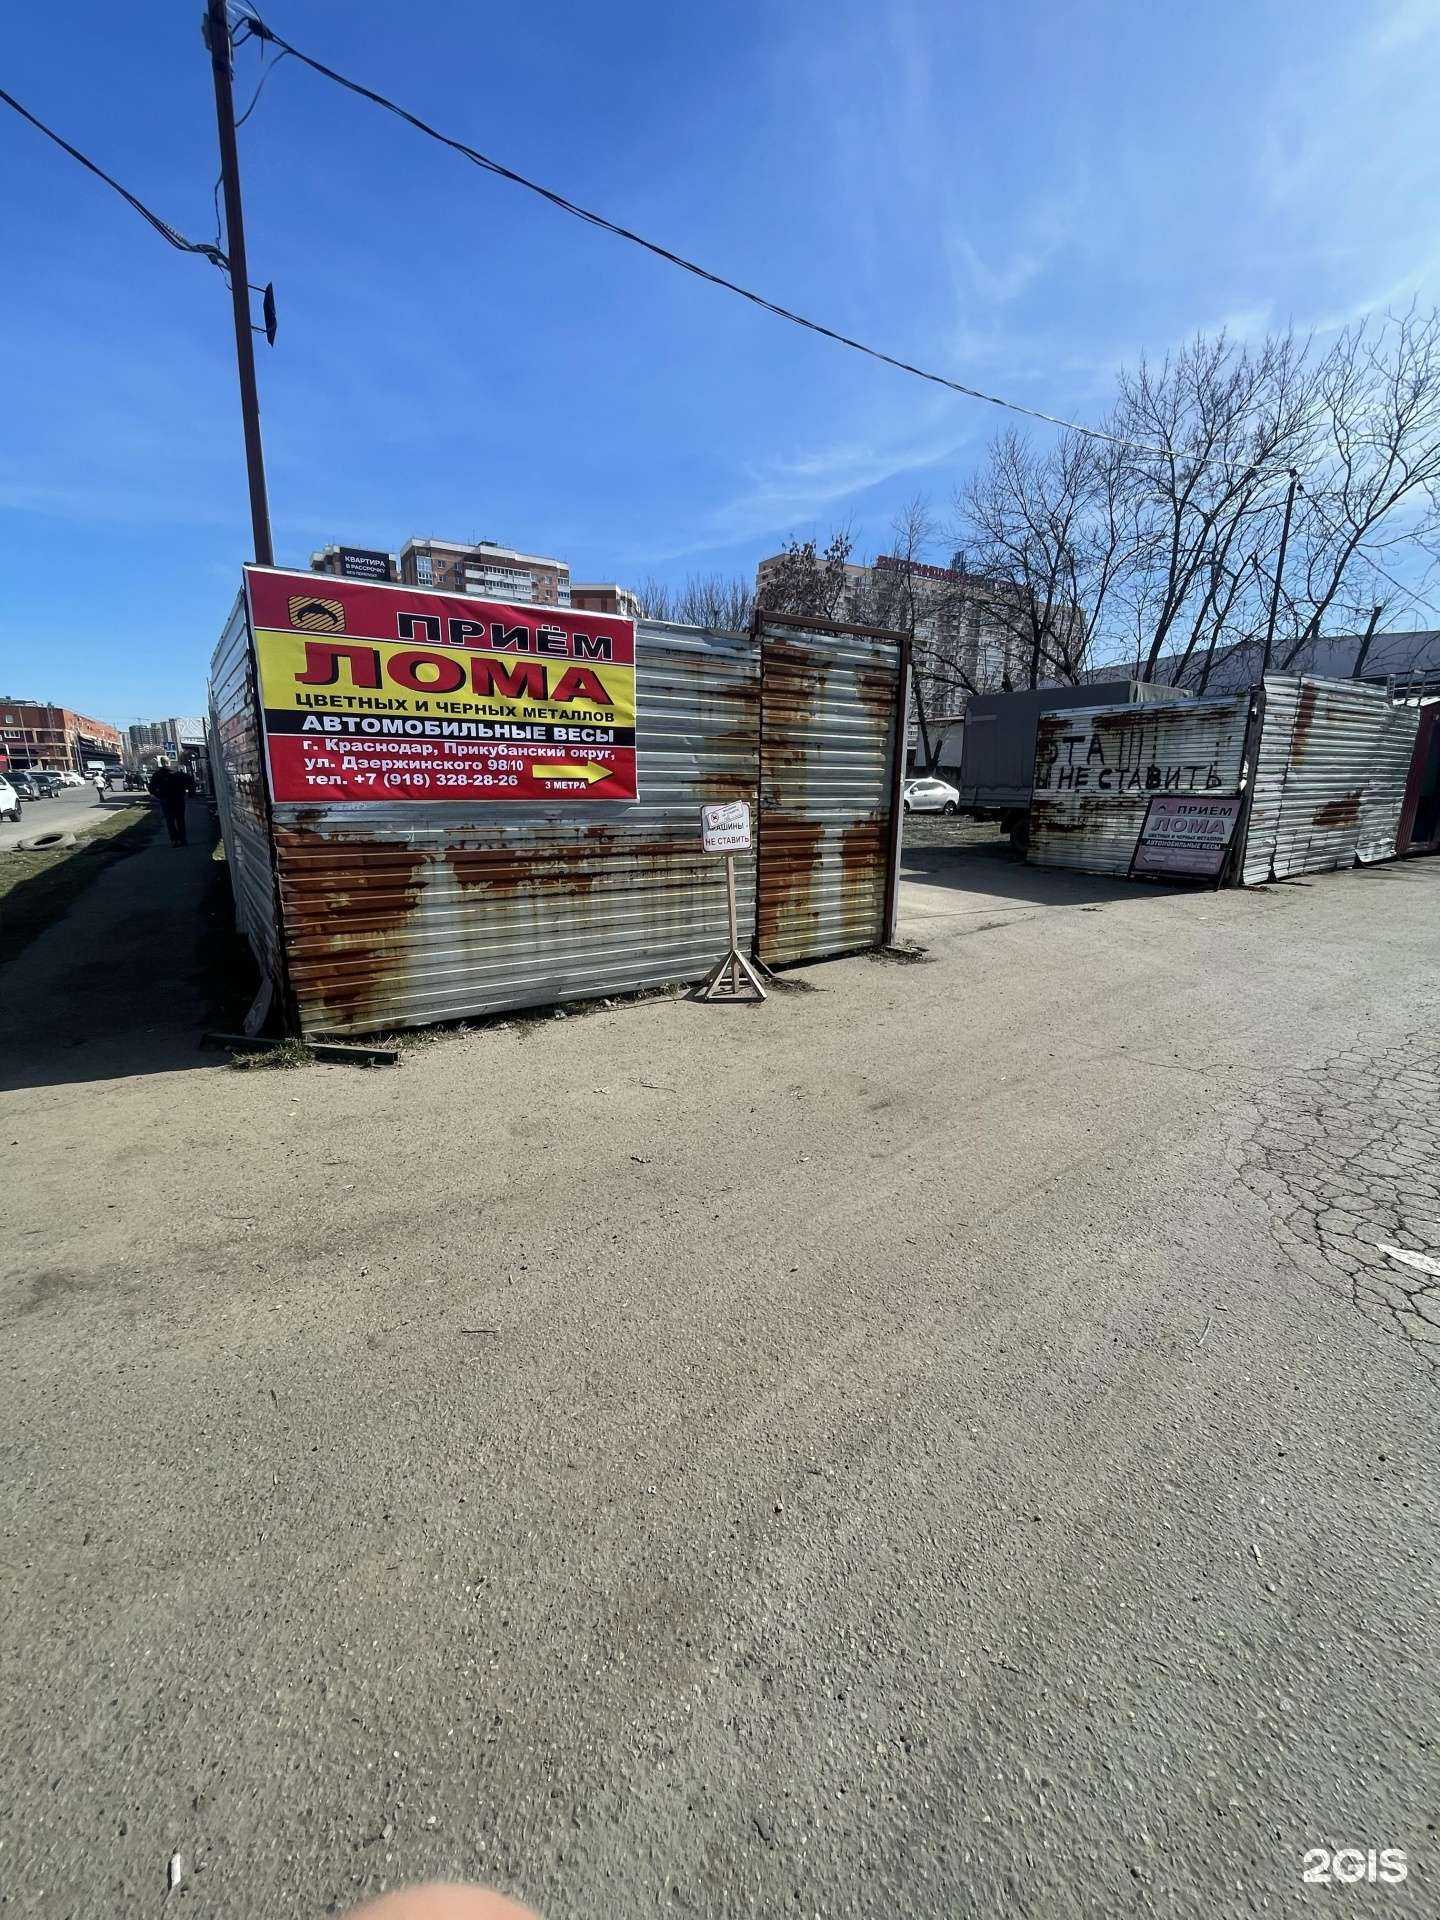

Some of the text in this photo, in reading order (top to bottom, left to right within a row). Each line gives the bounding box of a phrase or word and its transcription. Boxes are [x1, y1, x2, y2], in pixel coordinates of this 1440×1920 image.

[344, 555, 386, 567] КВАРТИРА
[351, 564, 386, 574] РАССРОЧКУ
[397, 611, 613, 661] ПРИЁМ
[294, 641, 615, 705] ЛОМА
[295, 693, 615, 722] ЦВЕТНЫХ И ЧЕРНЫХ МЕТАЛЛОВ
[301, 715, 614, 743] АВТОМОБИЛЬНЫЕ ВЕСЫ
[302, 738, 615, 761] г. Краснодар, Прикубанский округ,
[304, 755, 524, 772] ул. Дзержинского 98/10
[305, 773, 519, 788] тел. +7 (918) 328-28-26
[1058, 766, 1090, 789] НЕ
[1099, 762, 1222, 790] СТАВИТЬ
[545, 781, 587, 790] 3 МЕТРА
[1150, 817, 1225, 834] ЛОМА
[705, 836, 750, 846] НЕ СТАВИТЬ
[1146, 839, 1201, 849] АВТОМОБИЛЬНЫЕ
